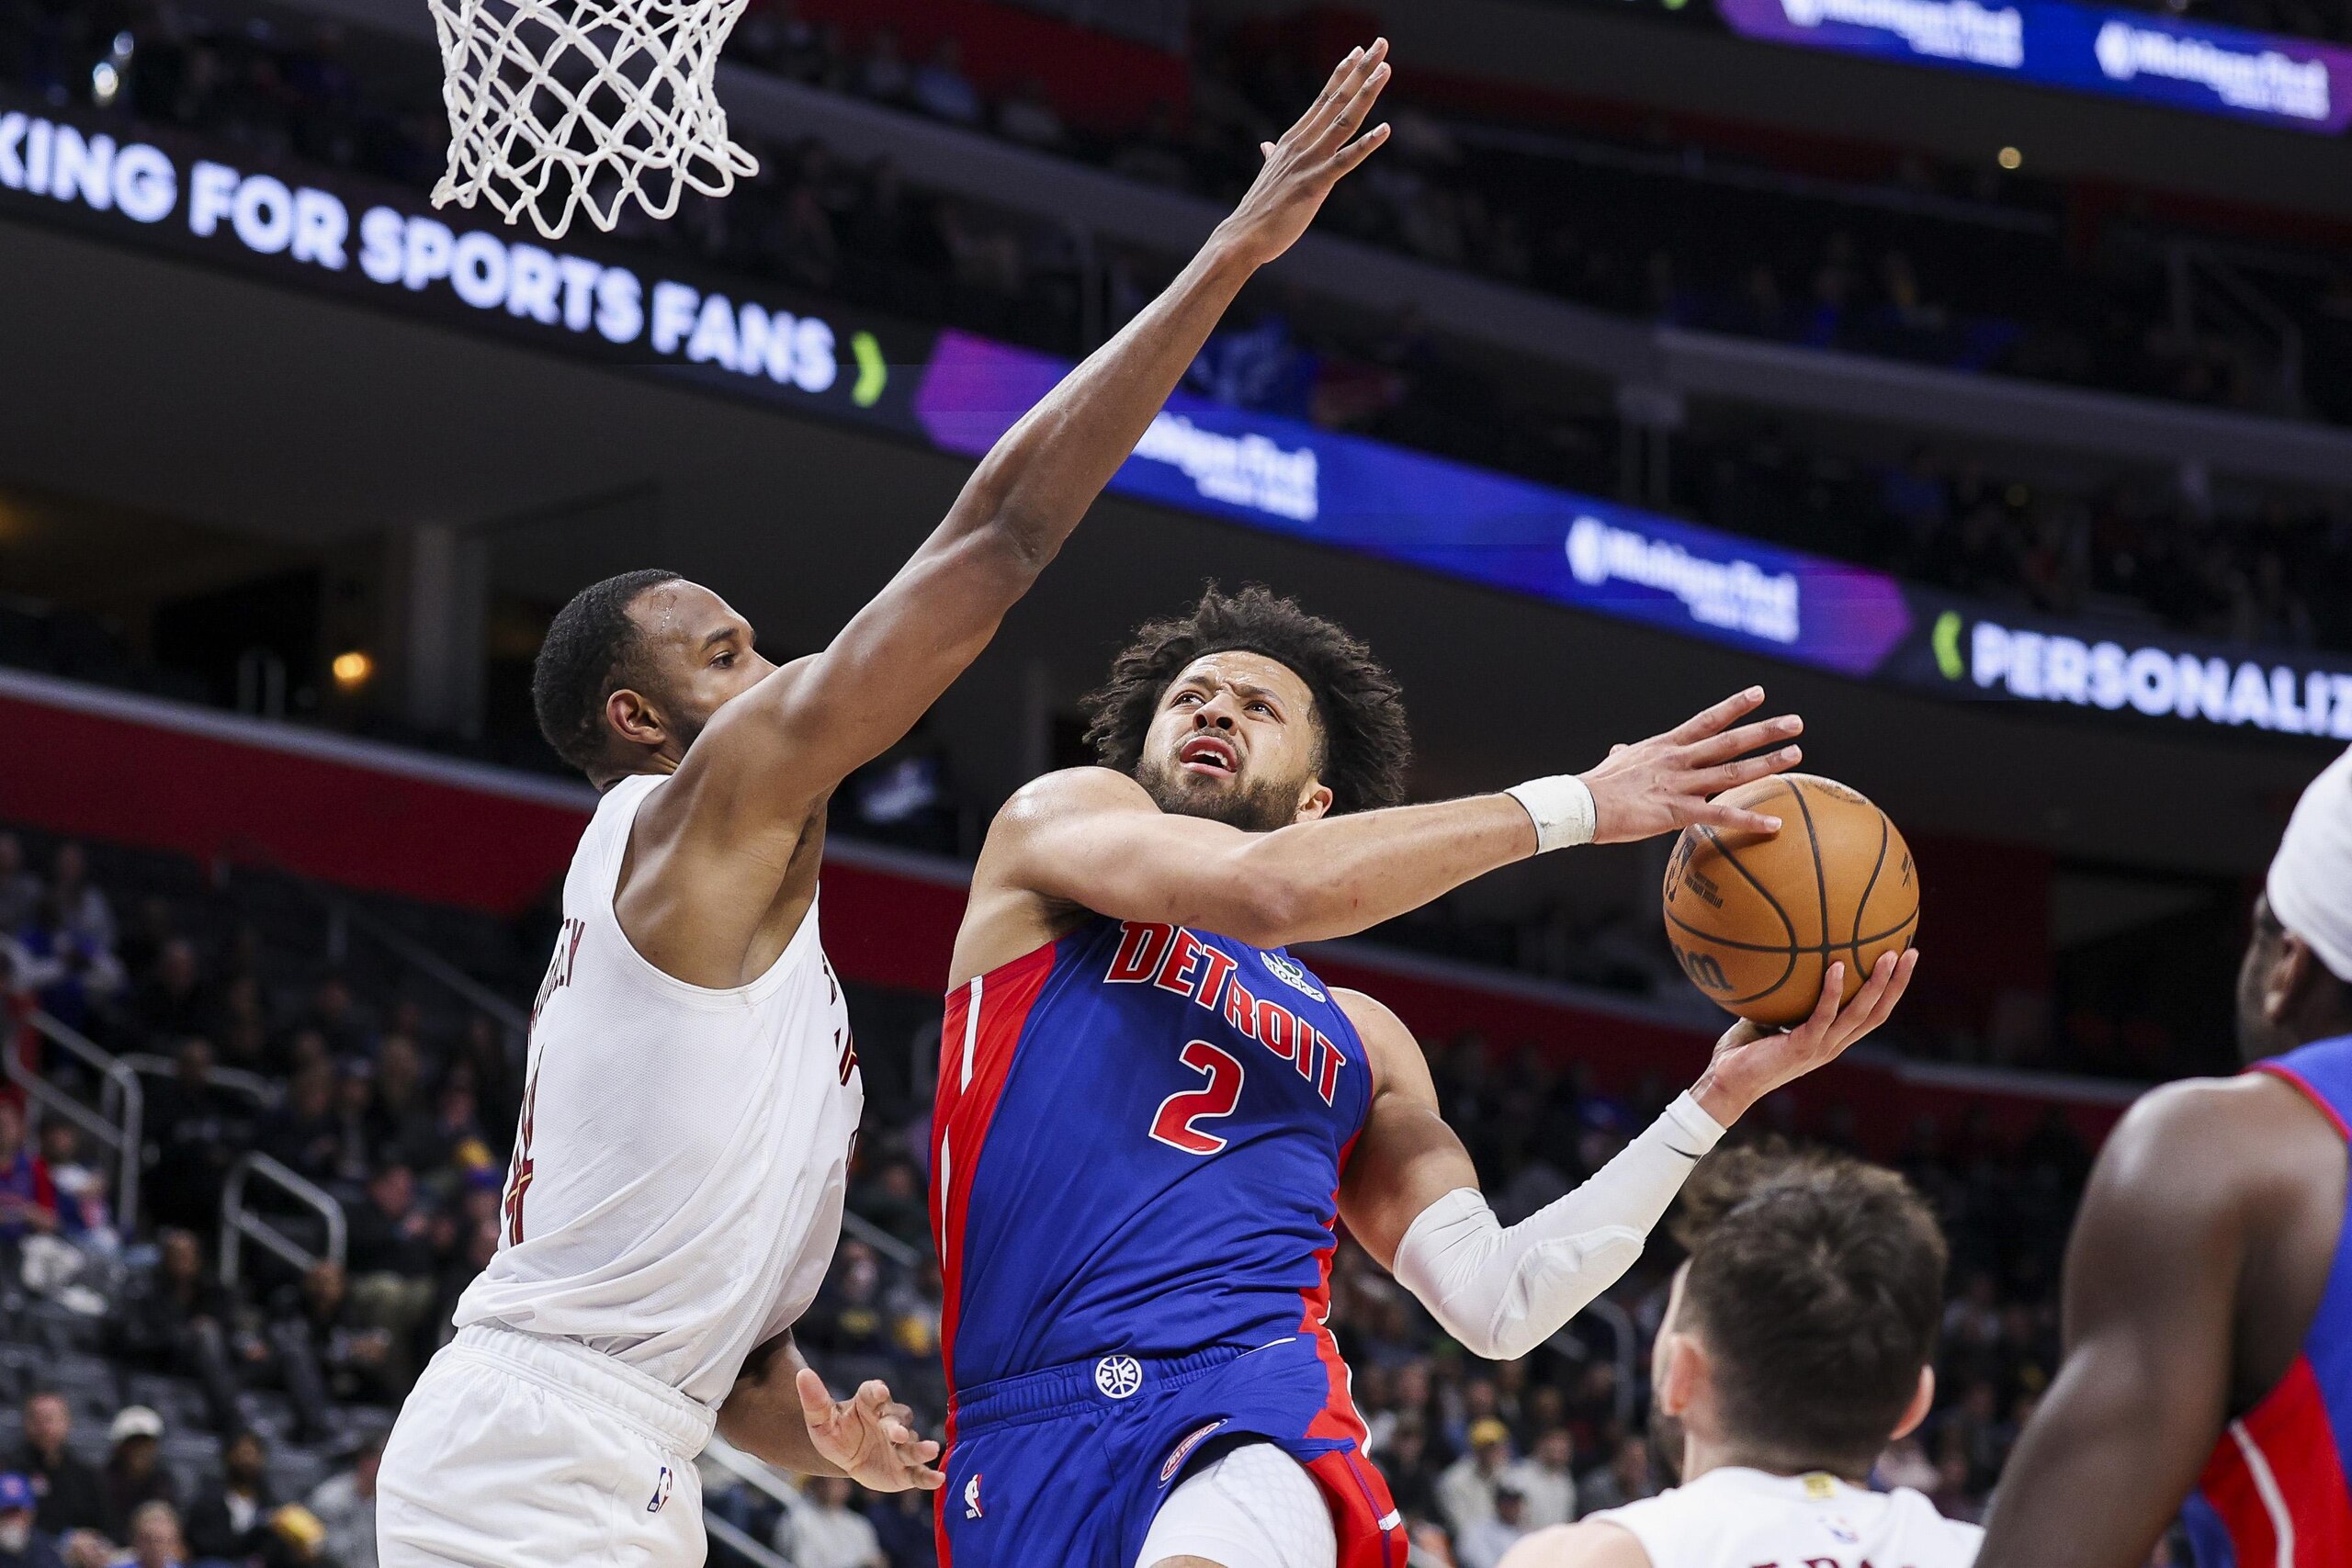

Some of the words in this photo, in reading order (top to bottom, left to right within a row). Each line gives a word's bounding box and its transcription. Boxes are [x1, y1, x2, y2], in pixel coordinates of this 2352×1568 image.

[188, 160, 350, 270] FOR
[359, 206, 643, 344] SPORTS
[651, 280, 837, 393] FANS
[1103, 920, 1346, 1108] DETROIT
[1148, 1039, 1245, 1156] 2
